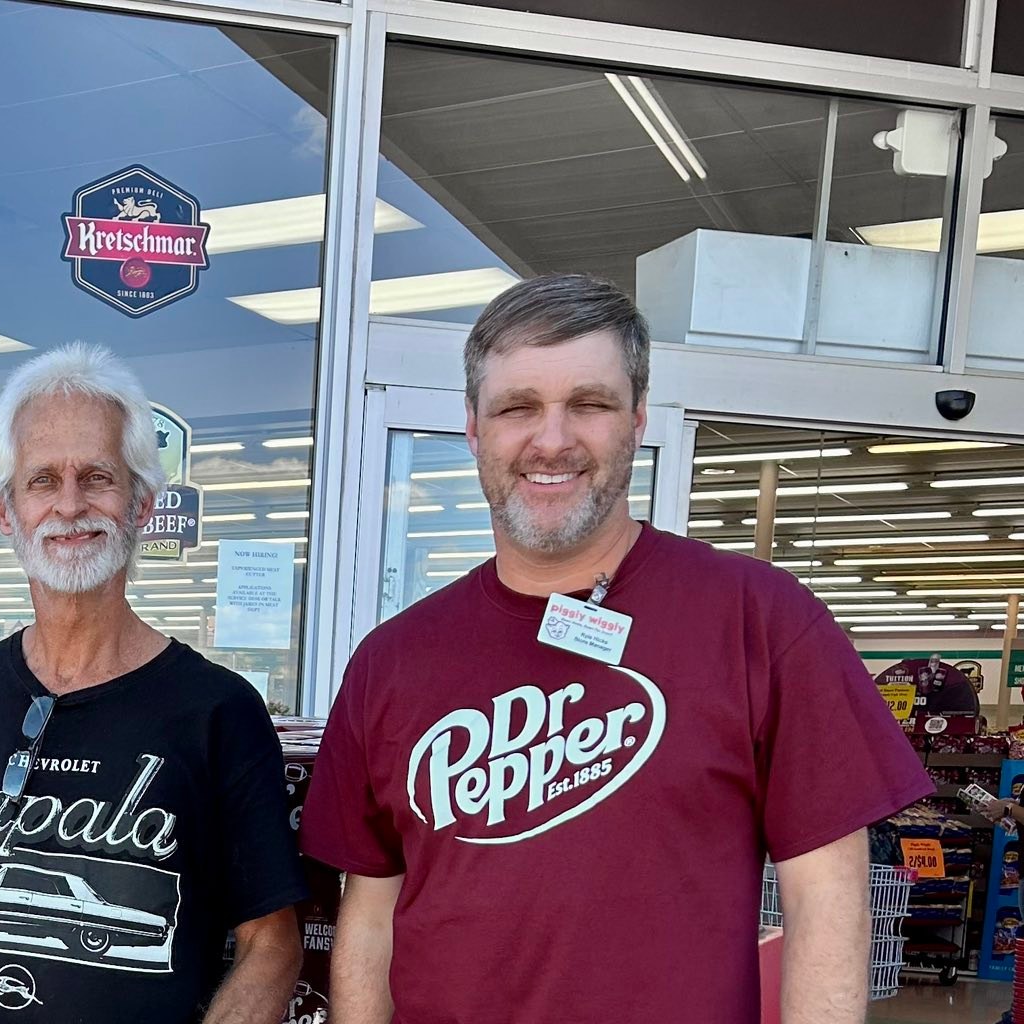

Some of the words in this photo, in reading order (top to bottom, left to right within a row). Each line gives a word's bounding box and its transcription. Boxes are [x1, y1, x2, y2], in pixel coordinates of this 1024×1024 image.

[112, 187, 144, 195] PREMIUM
[147, 188, 164, 199] DELI
[117, 290, 137, 298] SINCE
[141, 541, 177, 552] RAND
[550, 604, 586, 621] piggly
[588, 615, 625, 634] wiggly
[885, 675, 914, 683] TUITION
[488, 683, 585, 759] Dr
[409, 702, 646, 831] Pepper
[304, 923, 336, 936] WELCO
